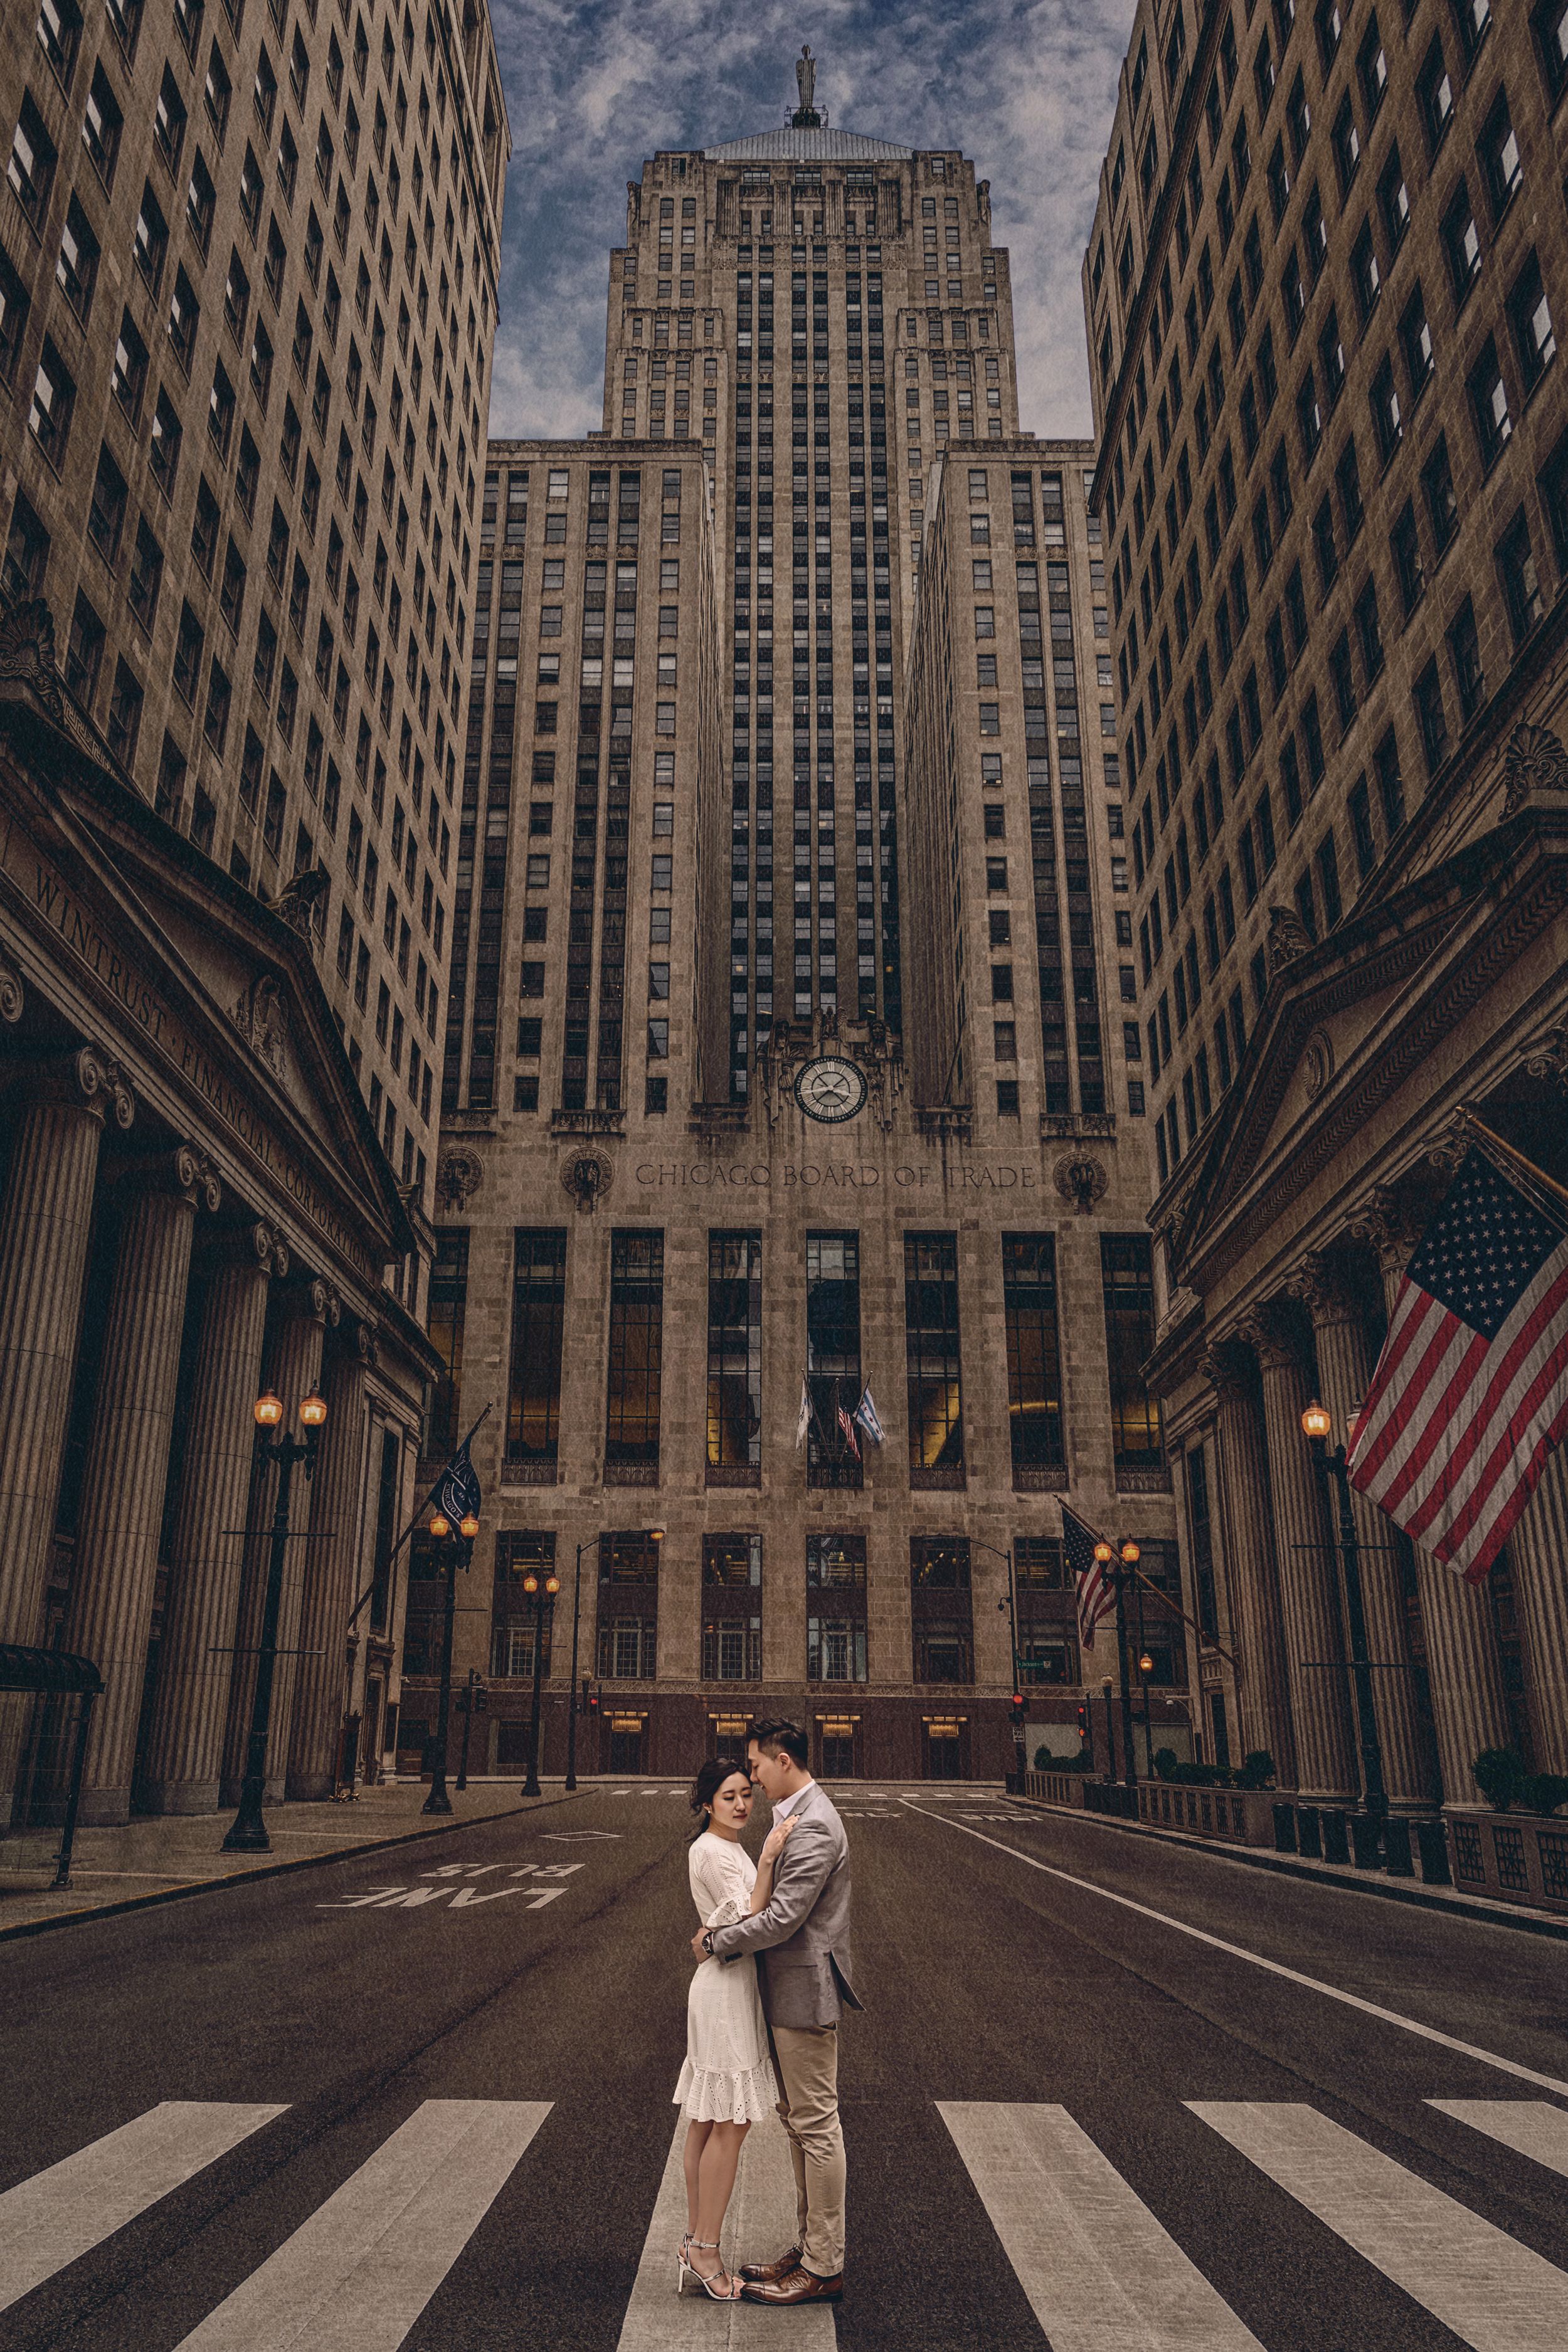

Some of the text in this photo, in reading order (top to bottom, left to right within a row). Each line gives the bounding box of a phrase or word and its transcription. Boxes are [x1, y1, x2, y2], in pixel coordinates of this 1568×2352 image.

[36, 862, 366, 1274] WINTRUST FINANCIAL CORPORATION
[636, 1164, 1036, 1189] CHICAGO BOARD OF TRADE
[444, 1483, 461, 1518] CHICAGO'S
[418, 1863, 586, 1877] BUS
[315, 1887, 569, 1909] LANE
